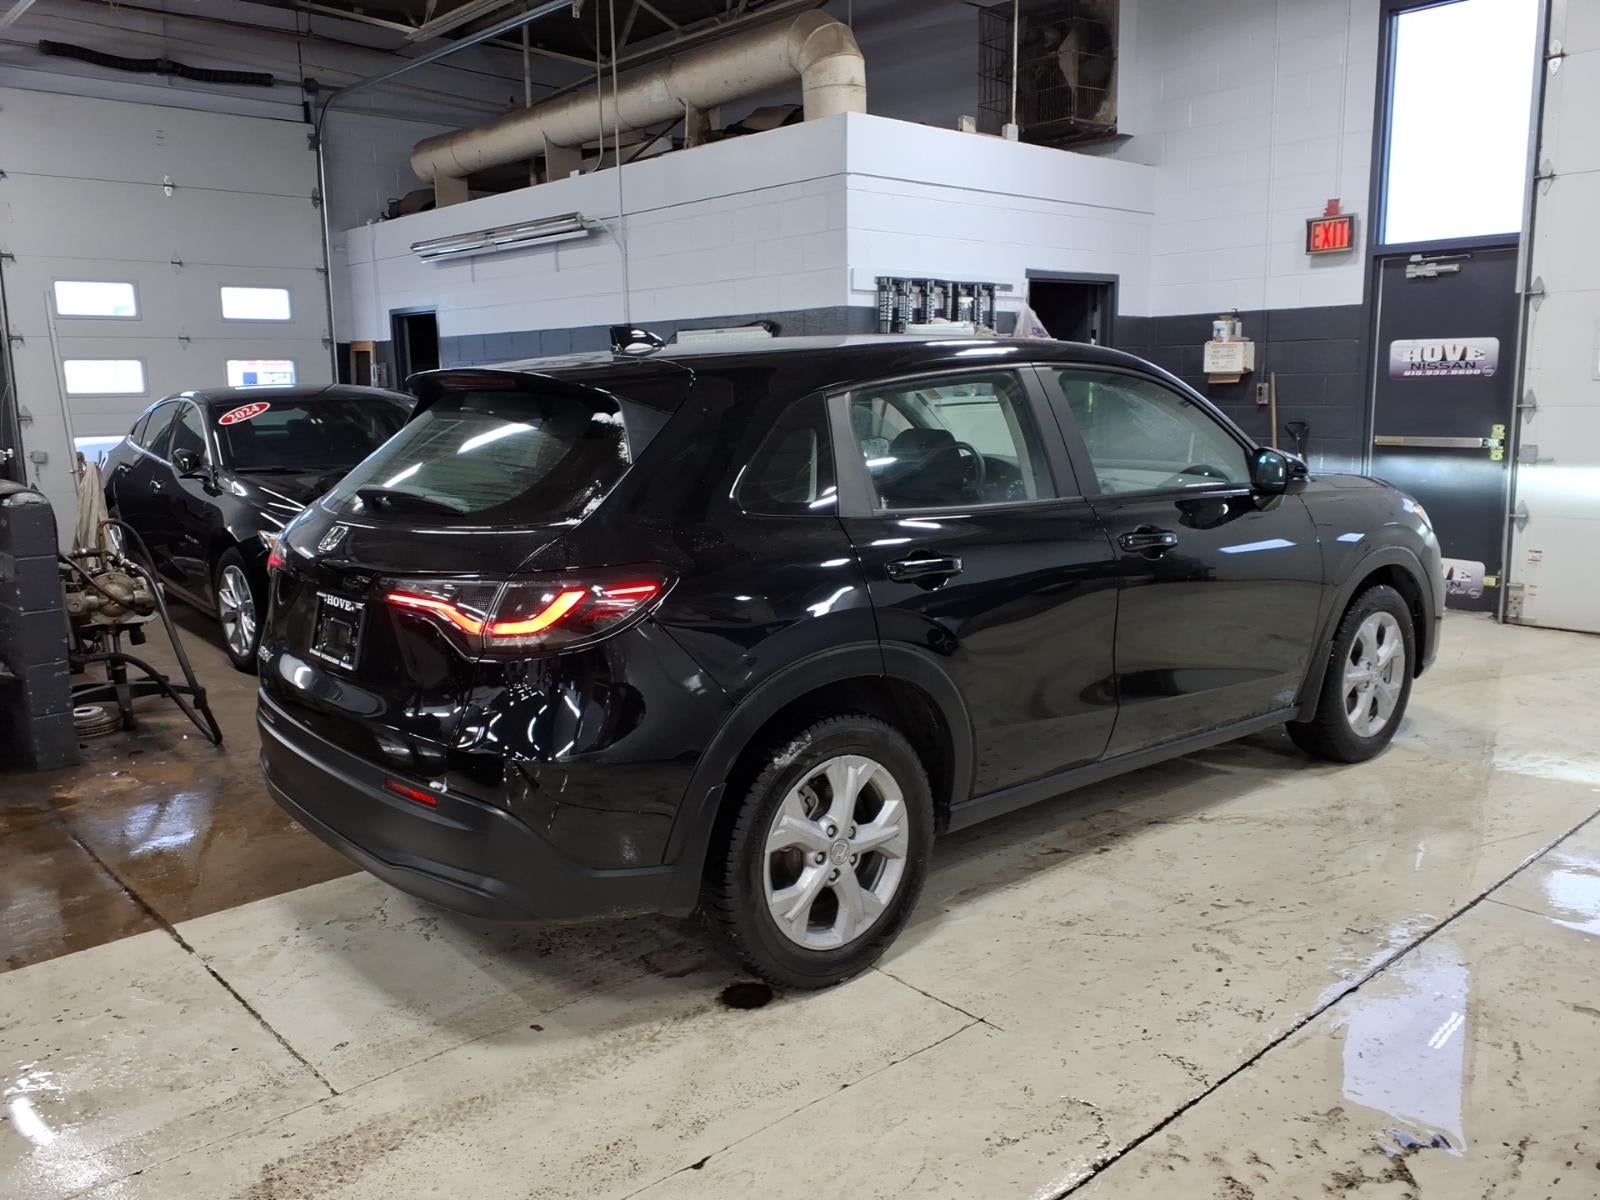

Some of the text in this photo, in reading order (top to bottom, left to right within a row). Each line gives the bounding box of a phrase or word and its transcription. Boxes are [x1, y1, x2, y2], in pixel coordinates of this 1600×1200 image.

[1312, 219, 1348, 249] EXIT
[1402, 344, 1486, 362] HOVE
[1410, 361, 1476, 370] NISSAN
[227, 405, 260, 422] 2024
[326, 594, 352, 612] HOVE
